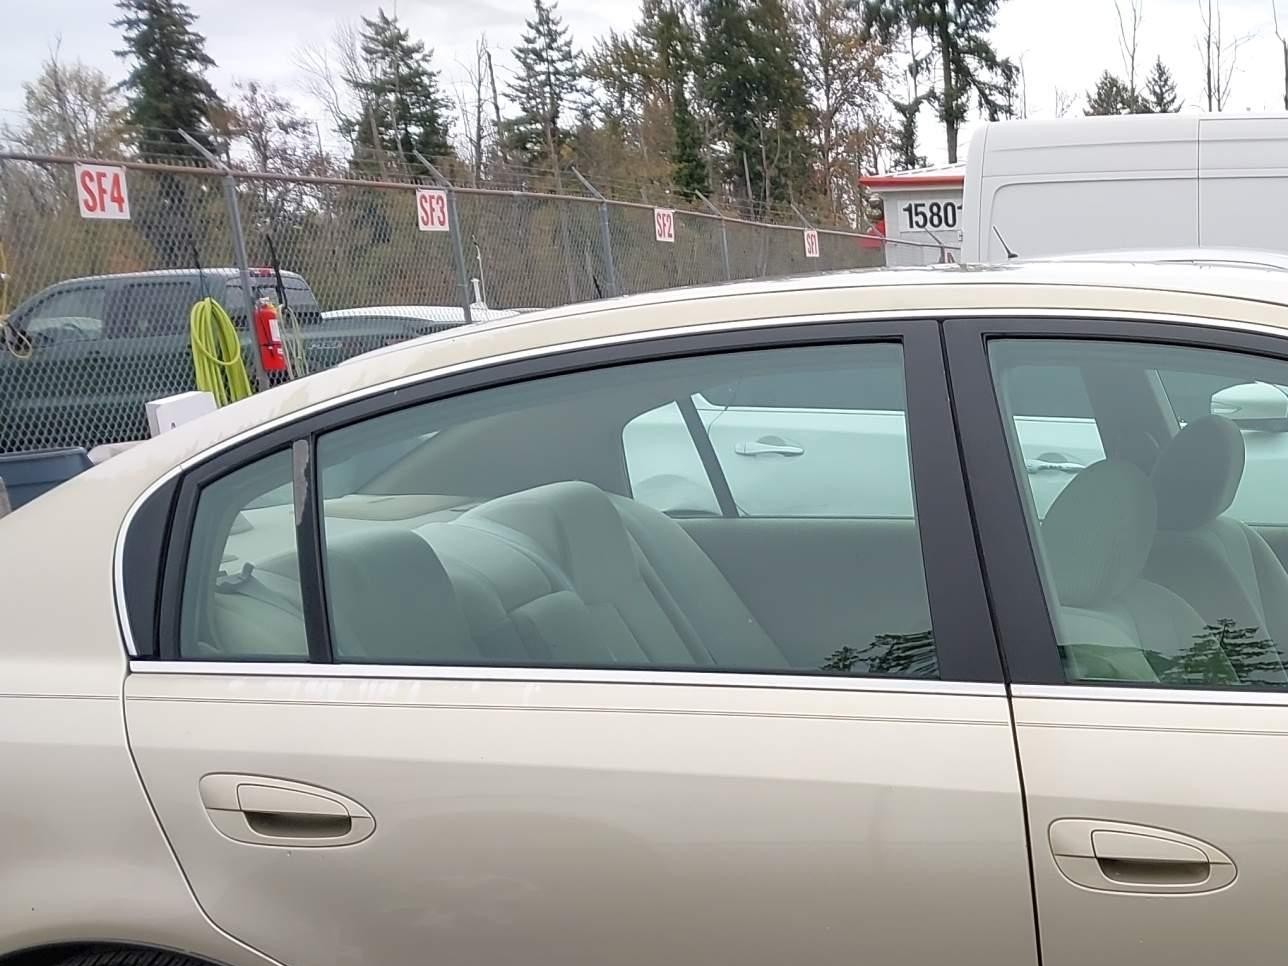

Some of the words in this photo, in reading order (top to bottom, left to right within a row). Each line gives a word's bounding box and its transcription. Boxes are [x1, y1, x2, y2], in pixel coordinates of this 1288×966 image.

[80, 170, 125, 213] SF4
[419, 194, 446, 226] SF3
[902, 202, 963, 229] 1580
[656, 212, 673, 239] SF2
[806, 232, 819, 256] SF1
